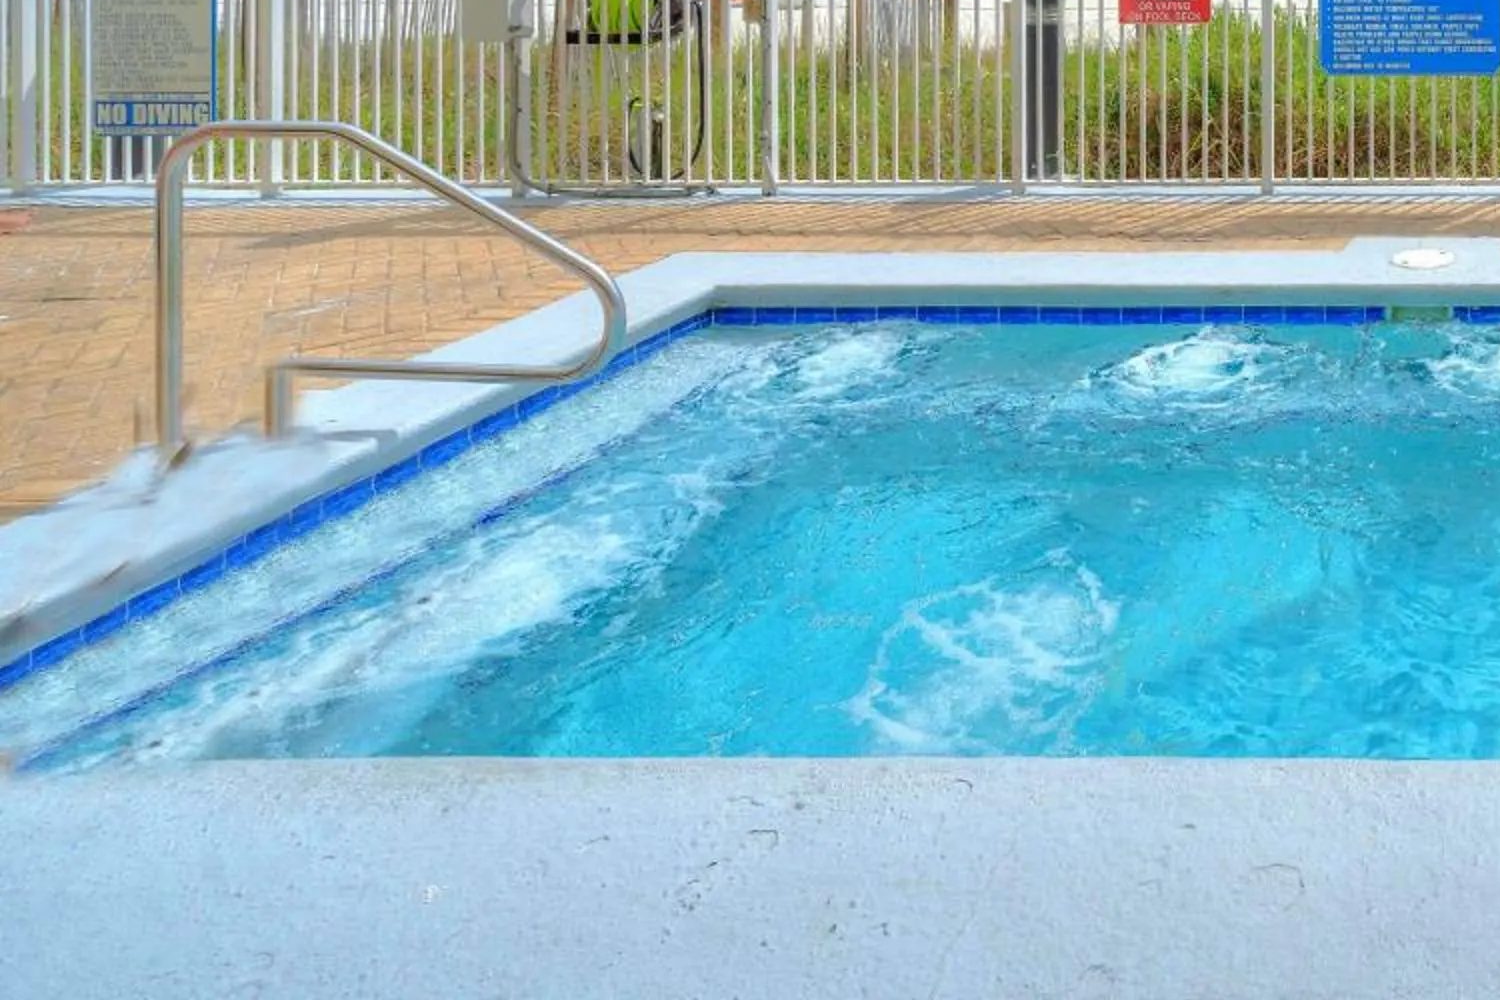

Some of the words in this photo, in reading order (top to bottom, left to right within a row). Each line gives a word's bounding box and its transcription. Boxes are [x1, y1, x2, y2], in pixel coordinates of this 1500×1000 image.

[1139, 1, 1153, 10] OR
[97, 103, 127, 125] NO
[133, 103, 209, 125] DIVING
